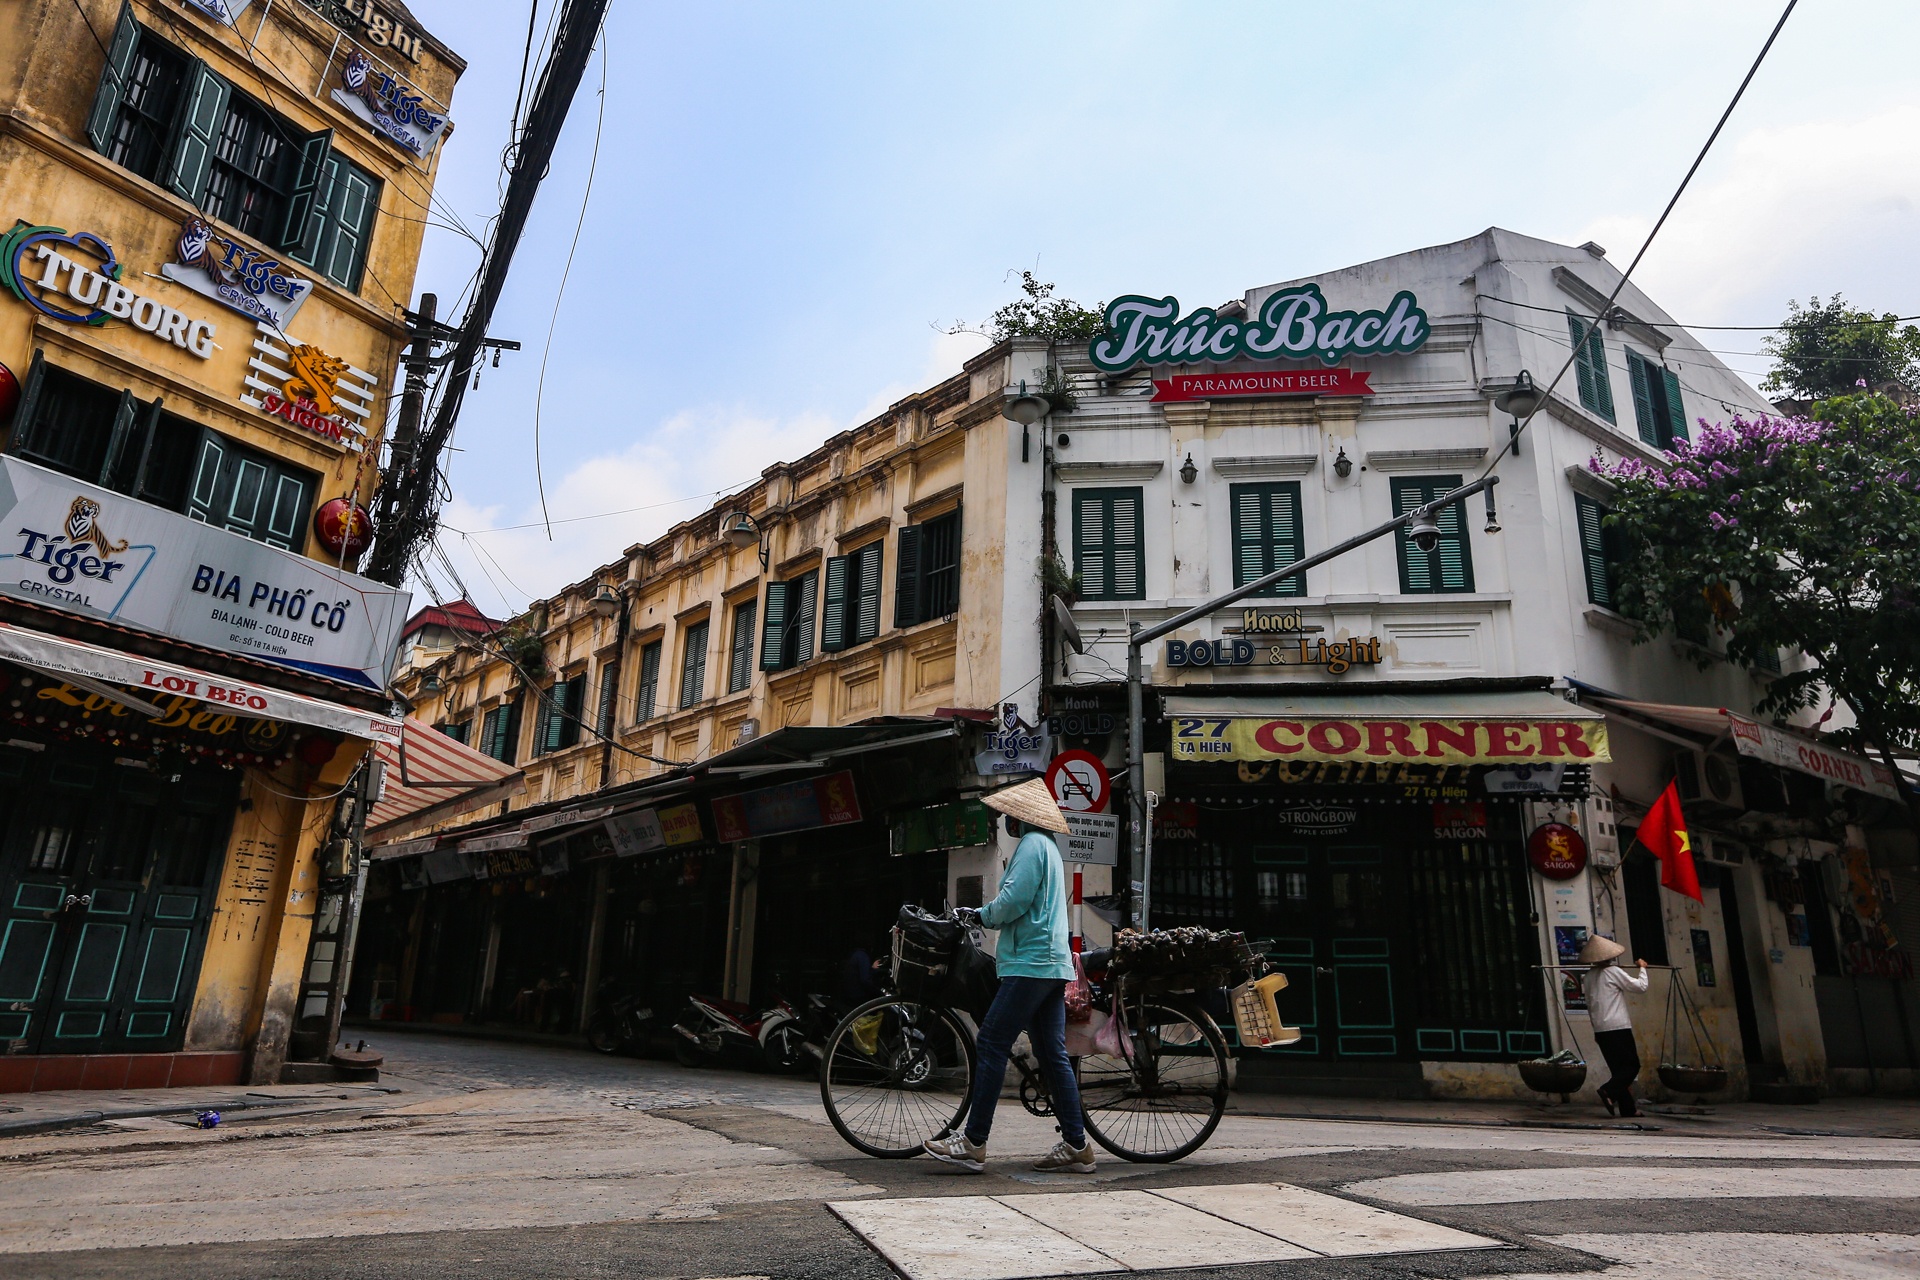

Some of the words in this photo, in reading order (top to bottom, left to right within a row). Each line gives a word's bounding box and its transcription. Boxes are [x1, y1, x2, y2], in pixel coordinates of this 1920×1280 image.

[377, 72, 442, 133] Tiger
[374, 111, 422, 151] CRYSTAL
[219, 238, 305, 302] Tiger
[36, 244, 216, 360] TUBORG
[219, 285, 279, 322] CRYSTAL
[1096, 302, 1237, 364] Trúc
[1245, 290, 1423, 358] Bạch
[1183, 376, 1293, 392] PARAMOUNT
[1299, 374, 1339, 387] BEER
[262, 394, 342, 443] SAIGON
[331, 535, 362, 546] SAGON
[16, 527, 125, 585] Tiger
[19, 579, 92, 607] CRYSTAL
[191, 564, 241, 604] BIA
[248, 581, 315, 620] PHỐ
[310, 599, 351, 633] CỔ
[210, 608, 228, 623] BIA
[230, 614, 258, 628] LẠNH
[264, 624, 289, 639] COLD
[290, 631, 315, 647] BEER
[1241, 606, 1303, 632] Hanoi
[242, 637, 253, 646] SỐ
[253, 640, 262, 648] 18
[262, 643, 271, 652] TẠ
[271, 646, 288, 656] HIỆN
[1166, 639, 1257, 667] BOLD
[1269, 645, 1286, 664] &
[1298, 636, 1382, 675] Light
[205, 688, 267, 710] BÉO
[1064, 696, 1100, 710] Hanoi
[1047, 713, 1116, 737] BOLD
[983, 729, 1042, 761] Tiger
[1178, 719, 1233, 738] 27
[1254, 720, 1595, 757] CORNER
[1180, 743, 1196, 755] TẠ
[1199, 739, 1232, 755] HIỆN
[992, 762, 1035, 771] CRYSTAL
[1798, 745, 1866, 788] CORNER
[1403, 787, 1419, 797] 27
[1423, 787, 1438, 798] Tạ
[1440, 786, 1468, 798] Hiện
[1502, 781, 1544, 790] CRYSTAL
[829, 811, 852, 822] SAIGON
[1164, 821, 1179, 829] BIA
[1279, 811, 1357, 824] STRONGBOW
[1451, 819, 1468, 827] BIA
[1152, 828, 1196, 840] AIGON
[1293, 827, 1317, 835] APPLE
[1320, 827, 1348, 835] CIDERS
[1434, 827, 1487, 840] SAIGON
[1069, 840, 1087, 851] NGOẠI
[1087, 840, 1095, 851] LỆ
[1070, 851, 1092, 860] Except
[1544, 861, 1575, 870] SAIGON
